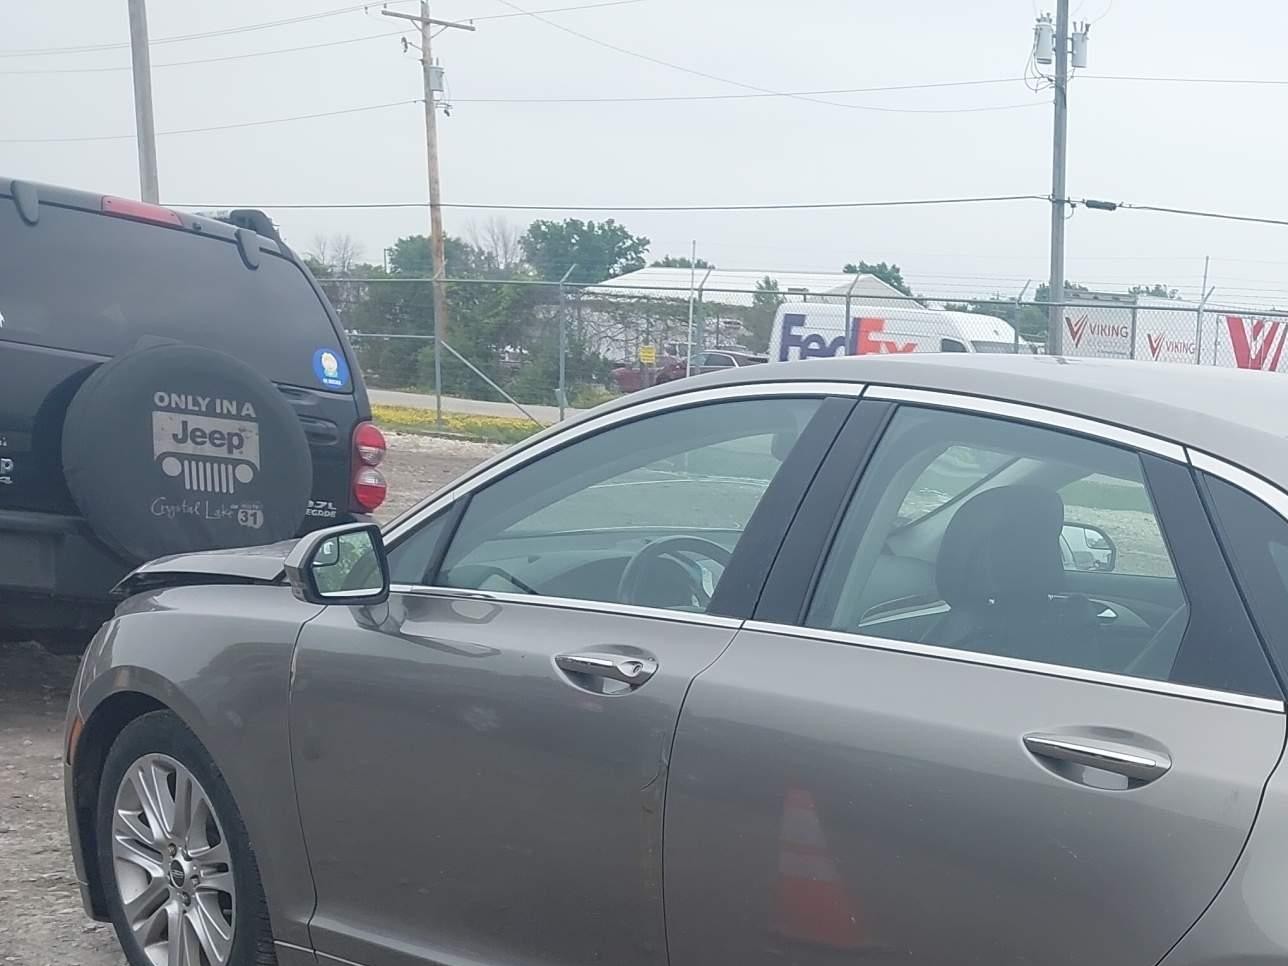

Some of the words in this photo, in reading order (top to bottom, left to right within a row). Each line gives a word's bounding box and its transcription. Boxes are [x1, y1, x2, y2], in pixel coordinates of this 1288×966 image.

[1089, 323, 1129, 338] VIKING
[1165, 340, 1196, 355] VIKING
[153, 391, 211, 412] ONLY
[215, 399, 237, 416] IN
[240, 402, 257, 418] A
[172, 420, 244, 455] Jeep
[239, 510, 259, 526] 31
